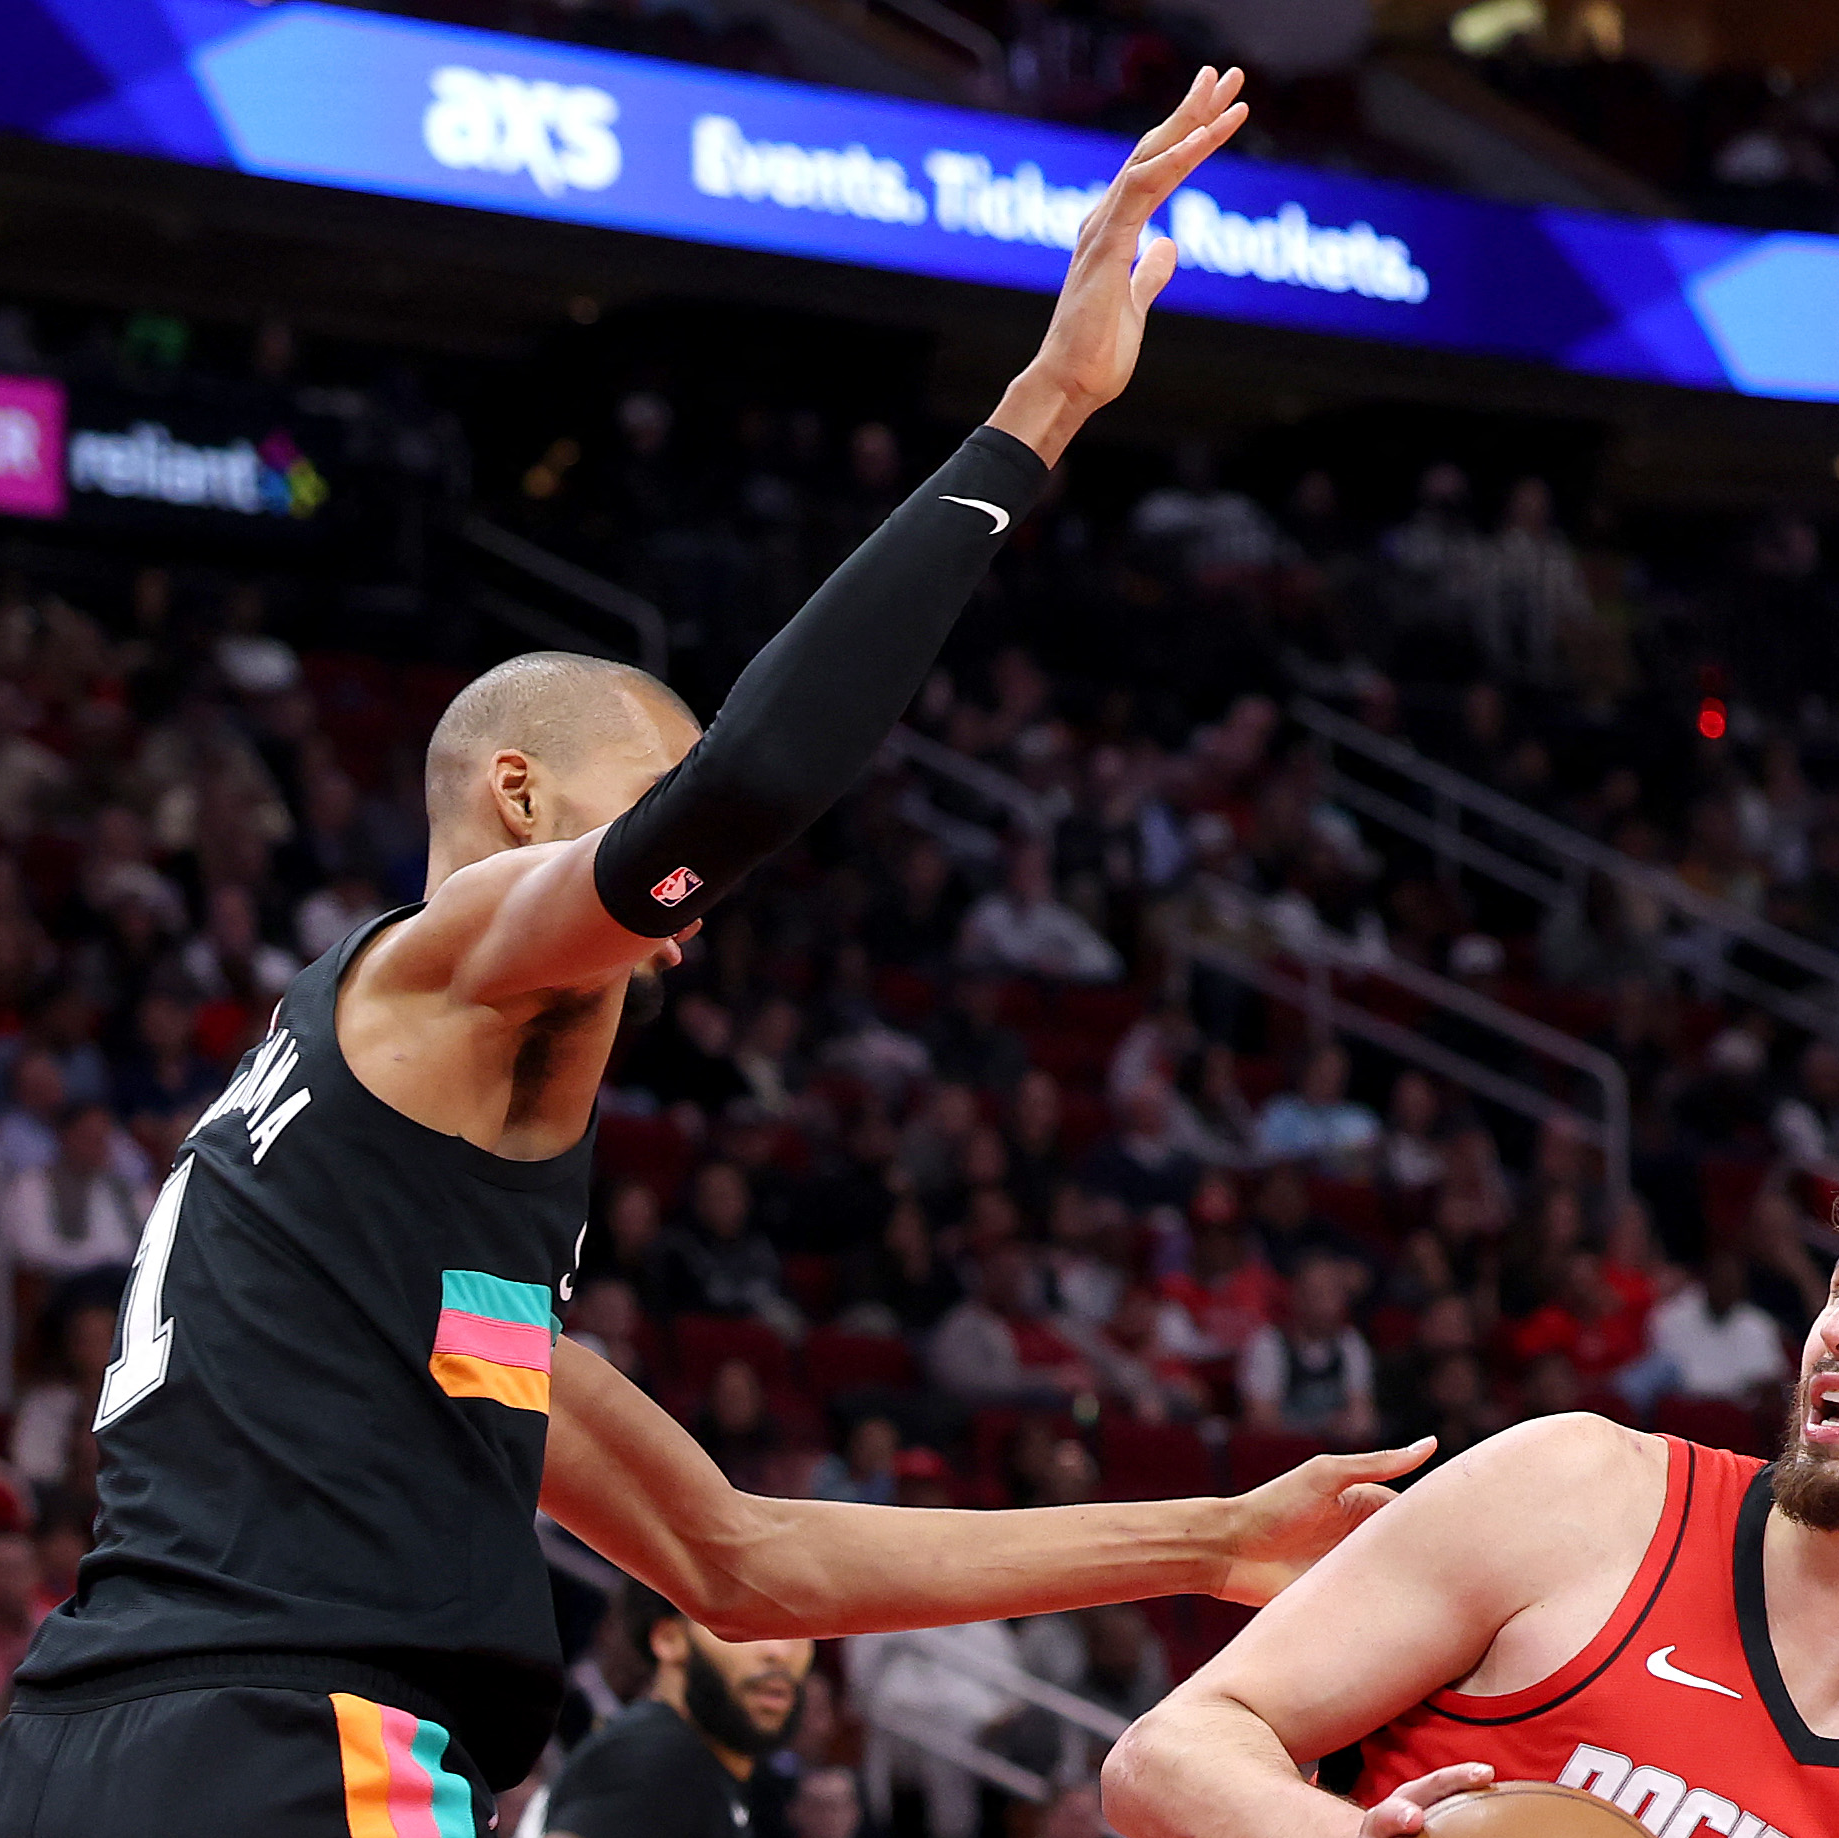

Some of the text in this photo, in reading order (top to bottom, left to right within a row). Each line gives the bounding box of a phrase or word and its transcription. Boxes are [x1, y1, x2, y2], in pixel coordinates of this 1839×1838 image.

[422, 65, 621, 193] axs
[691, 113, 1429, 304] Events. Ticke Rockets.
[68, 420, 263, 515] reliant
